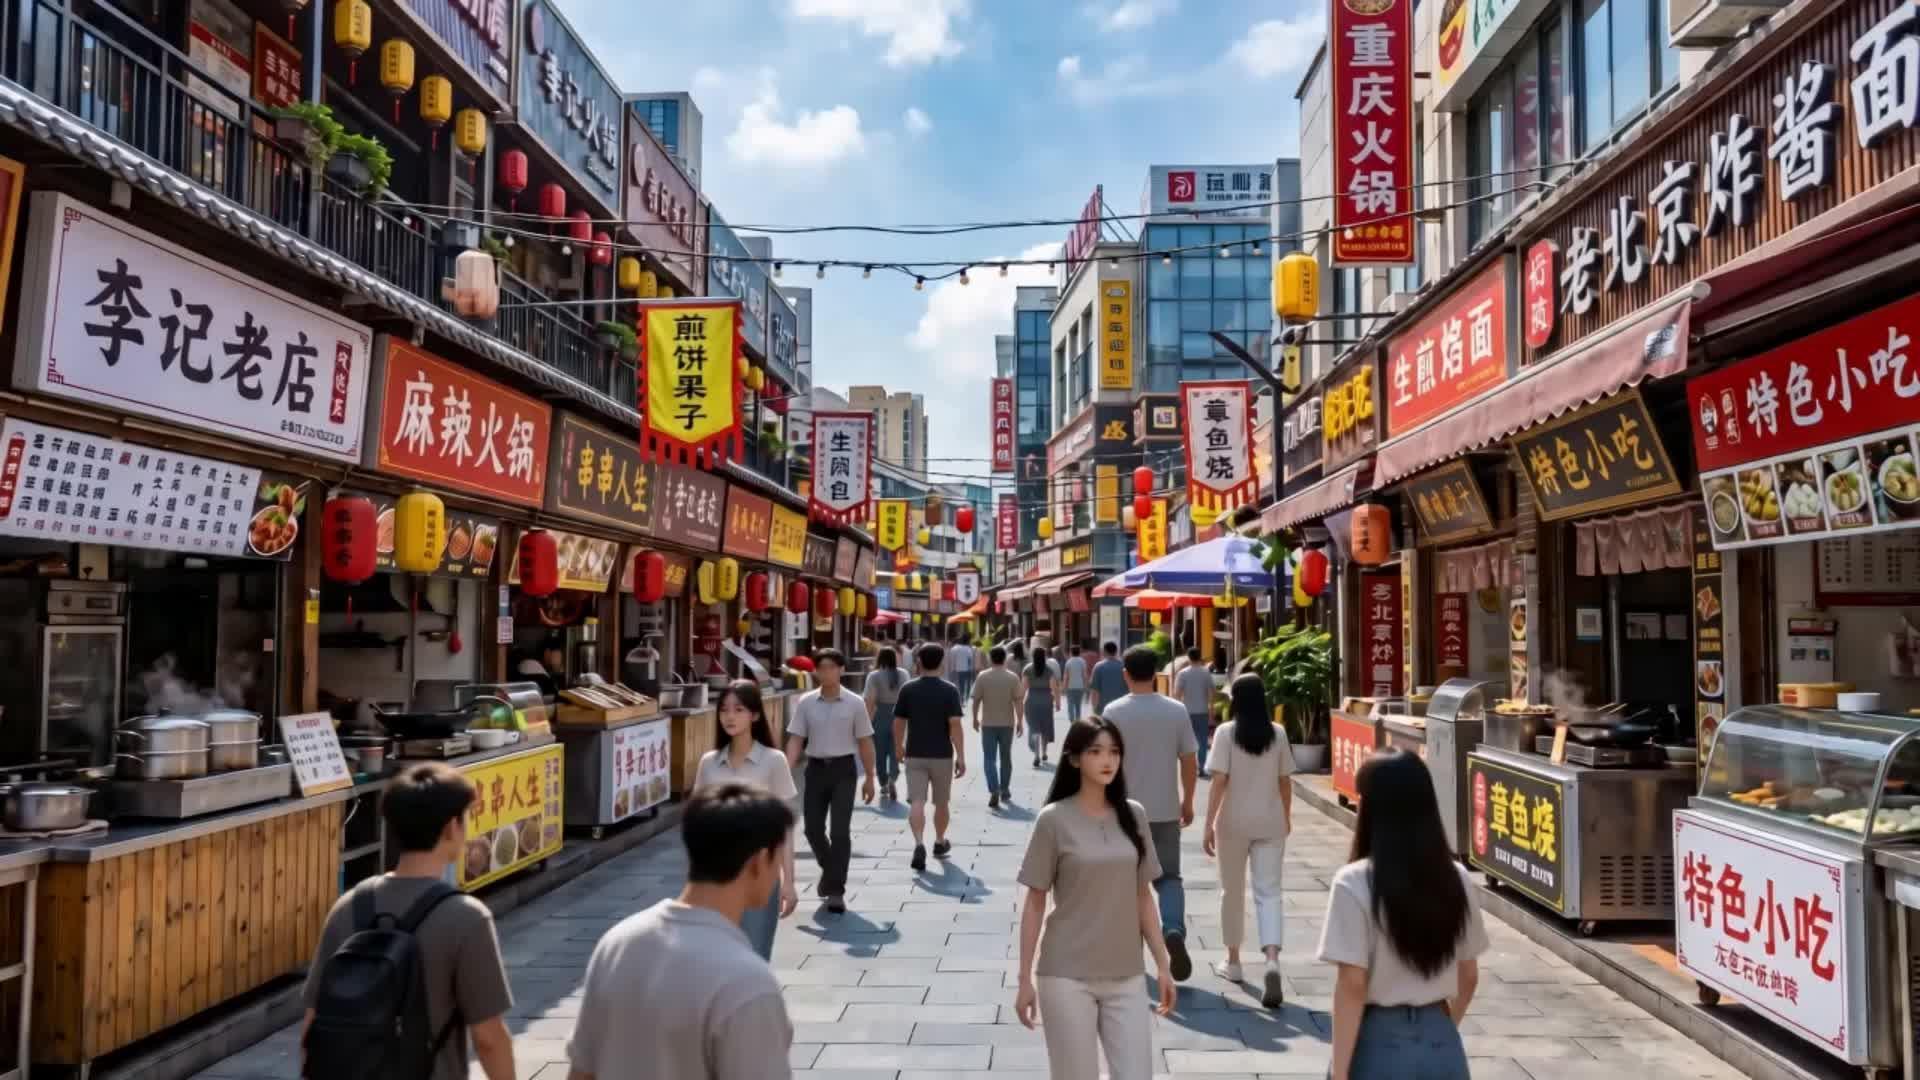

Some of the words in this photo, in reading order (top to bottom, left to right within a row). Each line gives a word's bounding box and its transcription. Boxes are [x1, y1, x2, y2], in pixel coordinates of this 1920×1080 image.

[1345, 23, 1397, 214] 重庆火锅
[1560, 5, 1920, 318] 老北京炸酱面
[84, 258, 318, 413] 李记老店
[673, 314, 706, 429] 煎饼果子
[1746, 326, 1920, 439] 特色小吃
[393, 370, 534, 484] 麻辣火锅
[578, 440, 648, 512] 串串人生
[1203, 398, 1234, 479] 章鱼烧
[1529, 413, 1655, 496] 特色小吃
[1490, 781, 1557, 863] 章鱼烧
[1682, 850, 1836, 982] 特色小吃
